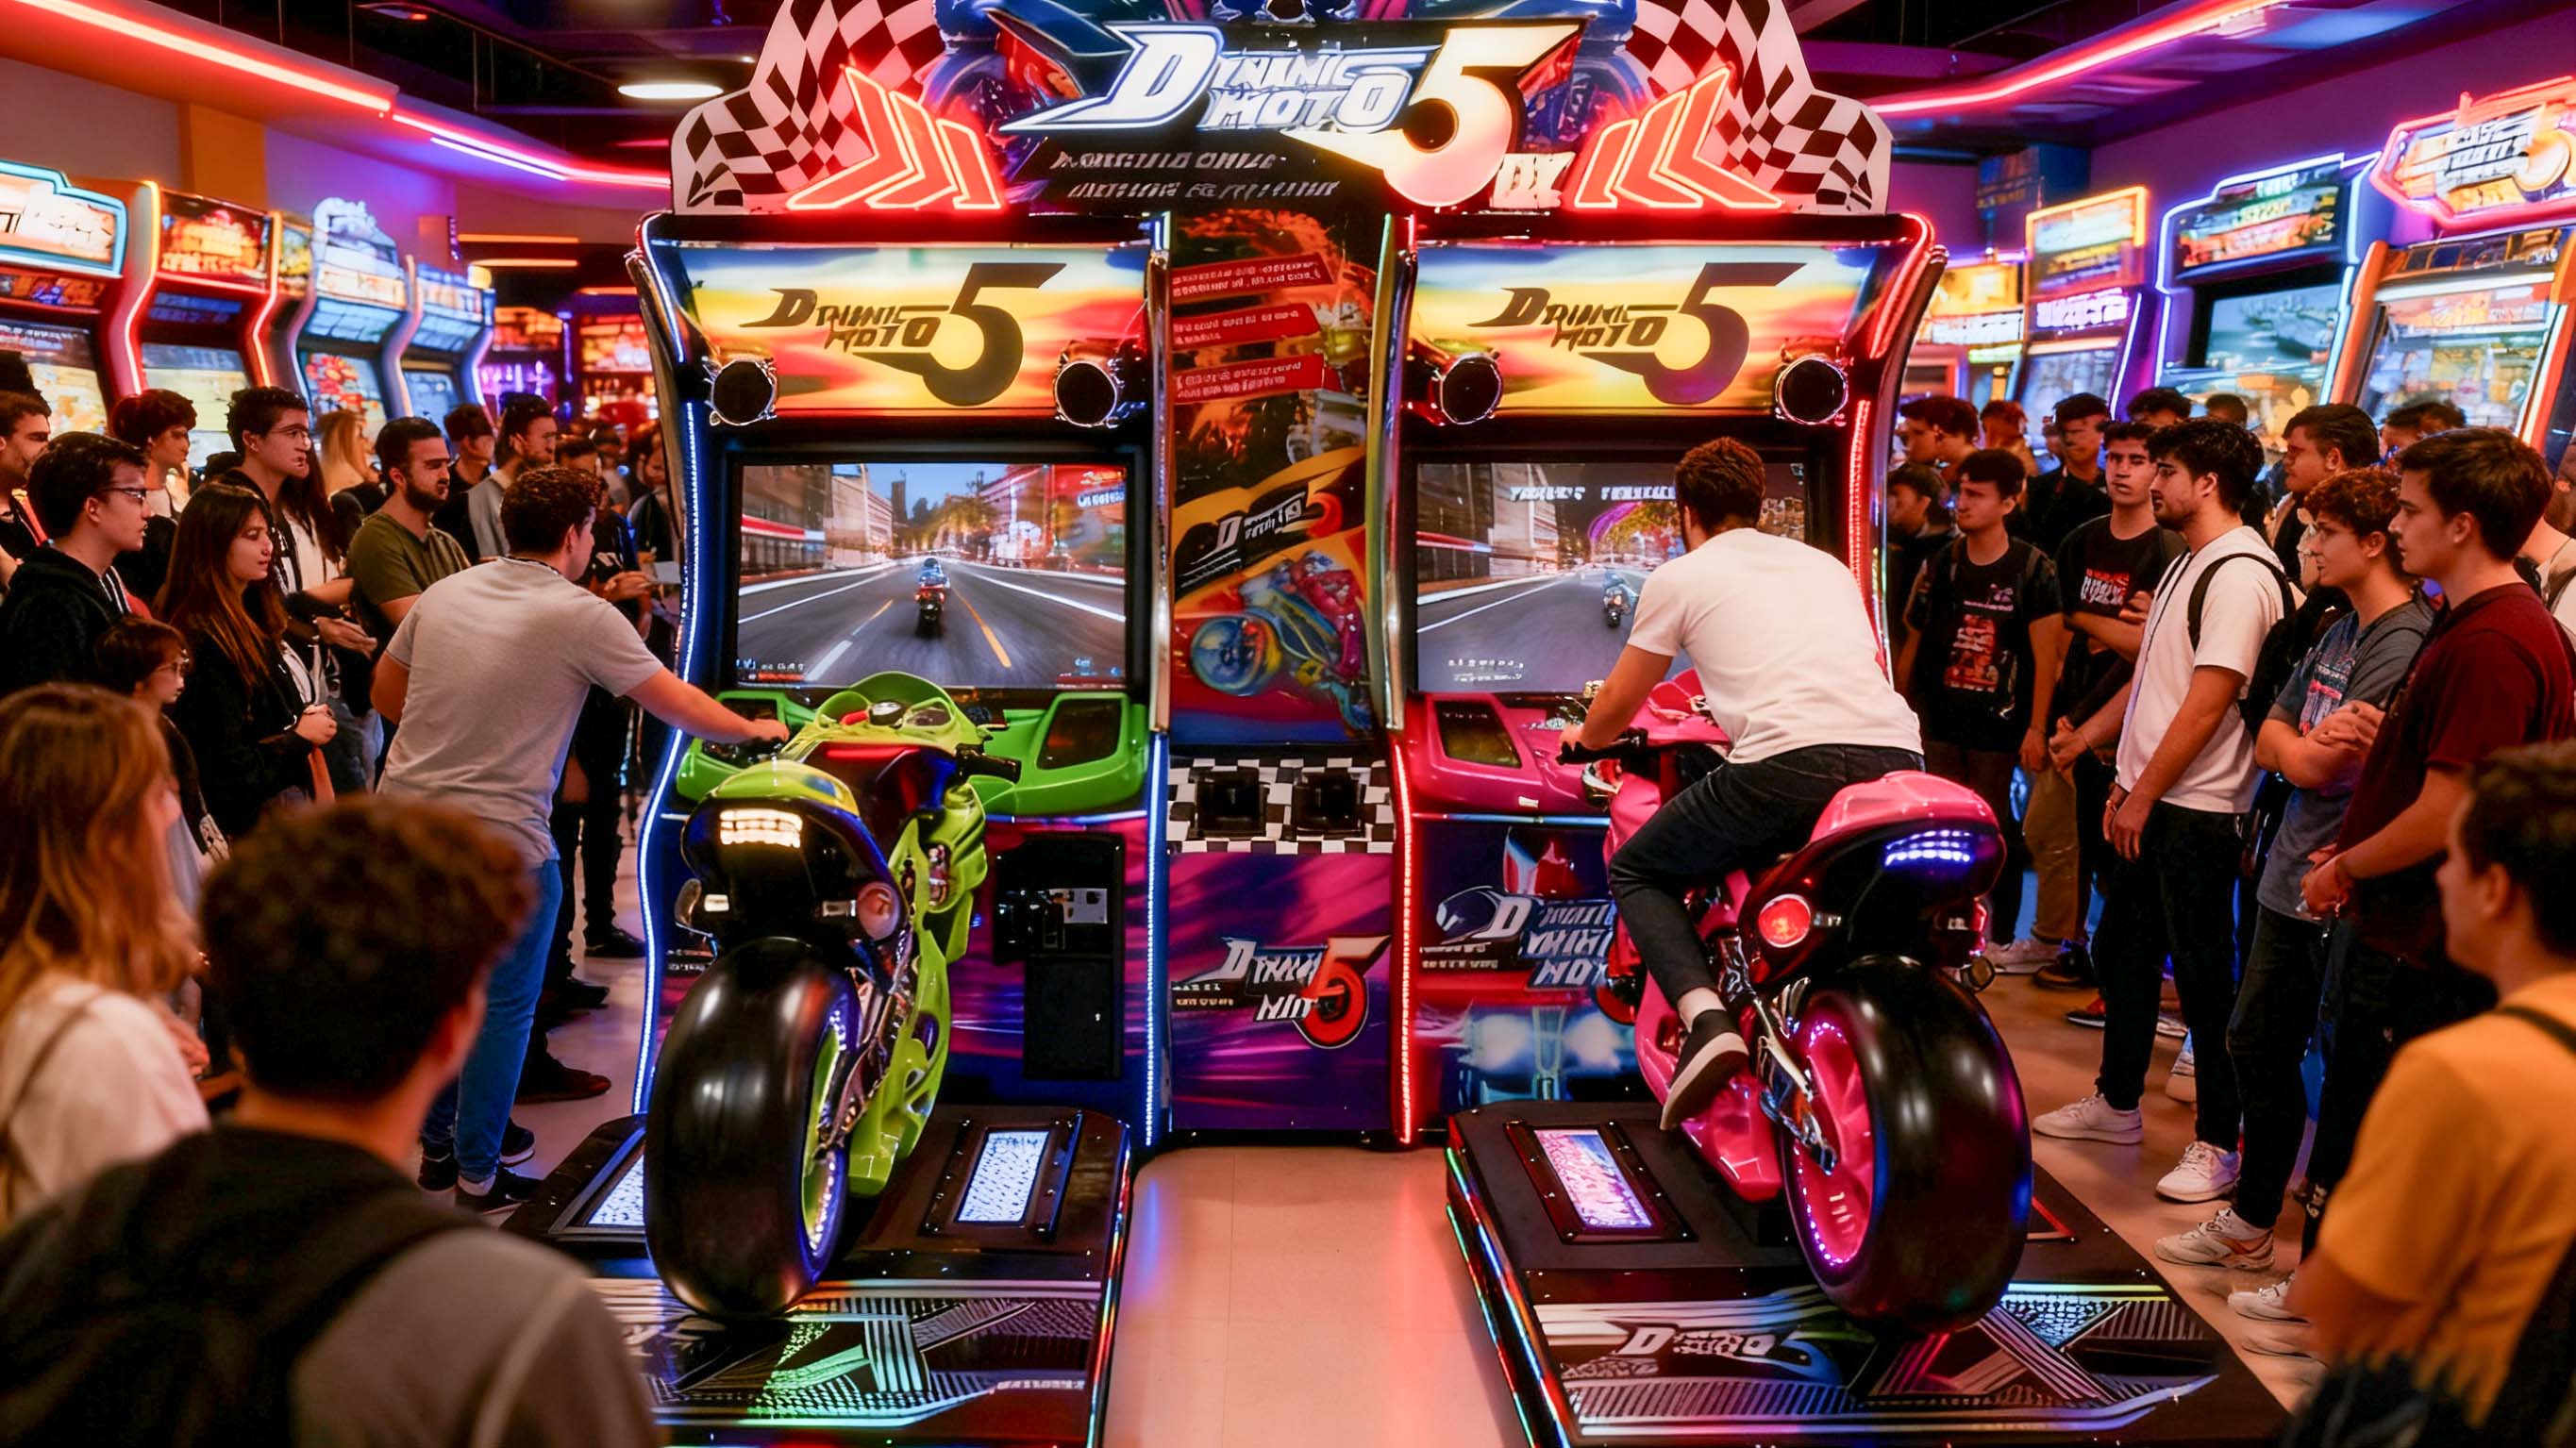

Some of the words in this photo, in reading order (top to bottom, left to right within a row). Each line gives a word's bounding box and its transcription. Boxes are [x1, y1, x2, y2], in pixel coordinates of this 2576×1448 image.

[1280, 23, 1582, 207] 5
[852, 262, 1067, 407] 5
[1579, 262, 1807, 406] 5
